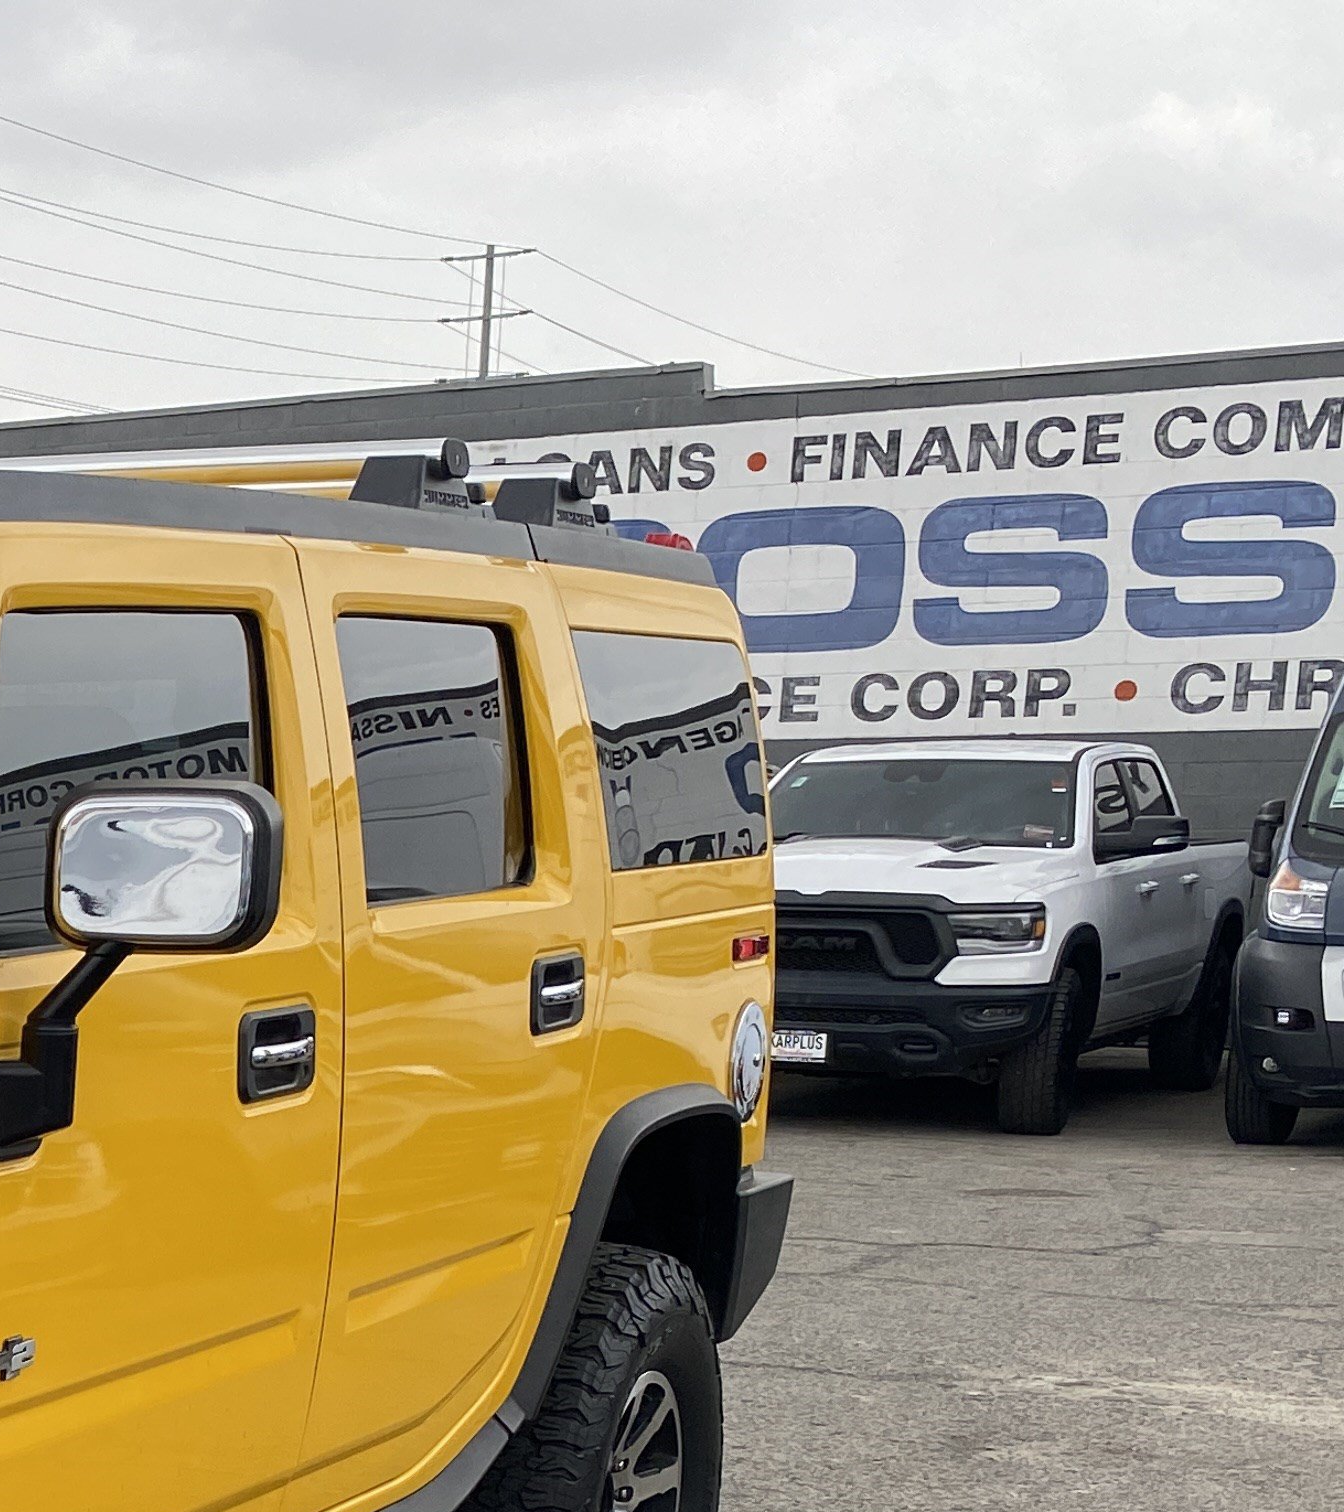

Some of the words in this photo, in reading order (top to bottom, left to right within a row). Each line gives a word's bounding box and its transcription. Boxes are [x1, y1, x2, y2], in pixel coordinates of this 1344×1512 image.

[790, 411, 1126, 484] FINANCE
[1153, 397, 1344, 460] COM
[610, 479, 1336, 654] OSS
[850, 668, 1077, 723] CORP.
